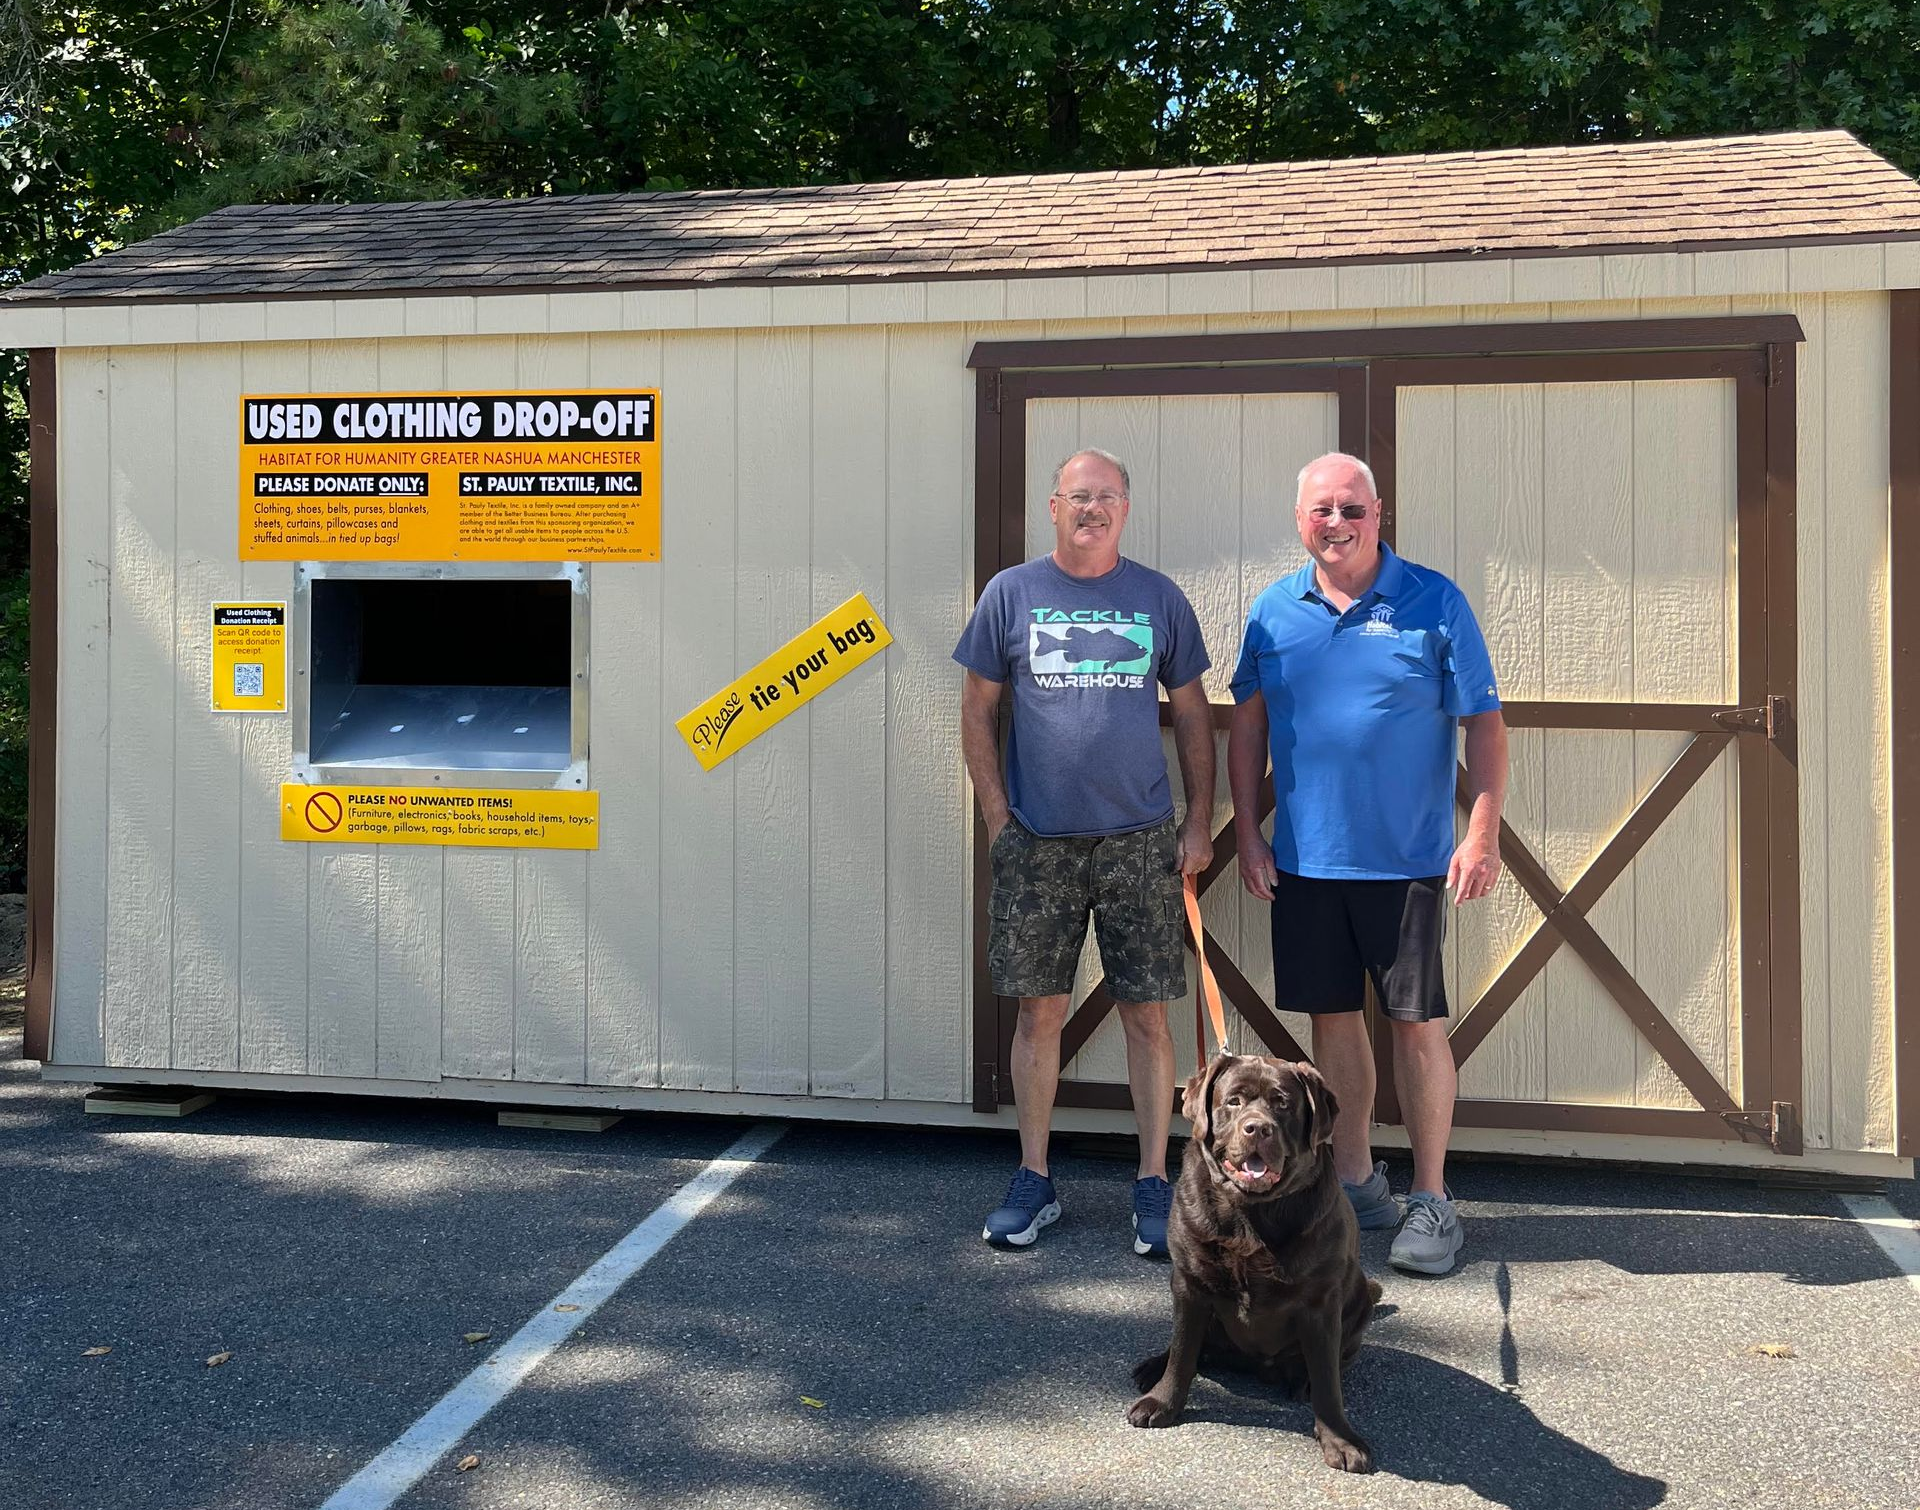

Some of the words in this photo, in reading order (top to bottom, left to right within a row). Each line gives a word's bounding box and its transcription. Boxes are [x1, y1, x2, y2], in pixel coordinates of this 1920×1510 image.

[249, 404, 322, 439] USED
[333, 402, 481, 439] CLOTHING
[494, 400, 650, 437] DROP-OFF
[259, 452, 314, 466] HABITAT
[316, 452, 342, 465] FOR
[345, 452, 417, 465] HUMANITY
[421, 452, 479, 465] GREATER
[484, 452, 543, 465] NASHUA
[547, 451, 641, 465] MANCHESTER
[259, 477, 310, 492] PLEASE
[314, 477, 374, 492] DONATE
[379, 477, 424, 495] ONLY:
[463, 477, 482, 493] ST.
[488, 477, 534, 492] PAULY
[539, 477, 600, 494] TEXTILE,
[605, 476, 638, 492] INC.
[254, 503, 294, 516] Clothing,
[297, 503, 324, 515] shoes,
[327, 503, 351, 515] belts,
[354, 505, 385, 518] purses,
[389, 503, 429, 515] blankets,
[254, 517, 282, 530] sheets,
[287, 518, 323, 530] curtains,
[326, 517, 378, 531] pillowcases
[381, 517, 398, 528] and
[254, 532, 282, 543] stuffed
[339, 532, 356, 543] tied
[360, 535, 371, 545] up
[374, 532, 400, 546] bags!
[1031, 608, 1150, 625] TACKLE
[692, 692, 740, 746] Please
[750, 686, 780, 711] tie
[782, 647, 828, 695] your
[827, 619, 875, 655] bag
[1034, 675, 1143, 688] WAREHOUSE
[348, 795, 385, 805] PLEASE
[389, 795, 406, 805] NO
[411, 796, 474, 807] UNWANTED
[478, 798, 512, 808] ITEMS!
[348, 808, 394, 820] (Furniture,
[453, 811, 483, 822] books,
[487, 812, 535, 823] household
[538, 813, 565, 825] items,
[348, 822, 390, 834] garbage,
[394, 822, 428, 835] pillows,
[432, 825, 455, 835] rags,
[458, 823, 486, 834] fabric
[489, 826, 520, 837] scraps,
[525, 826, 544, 837] etc.)
